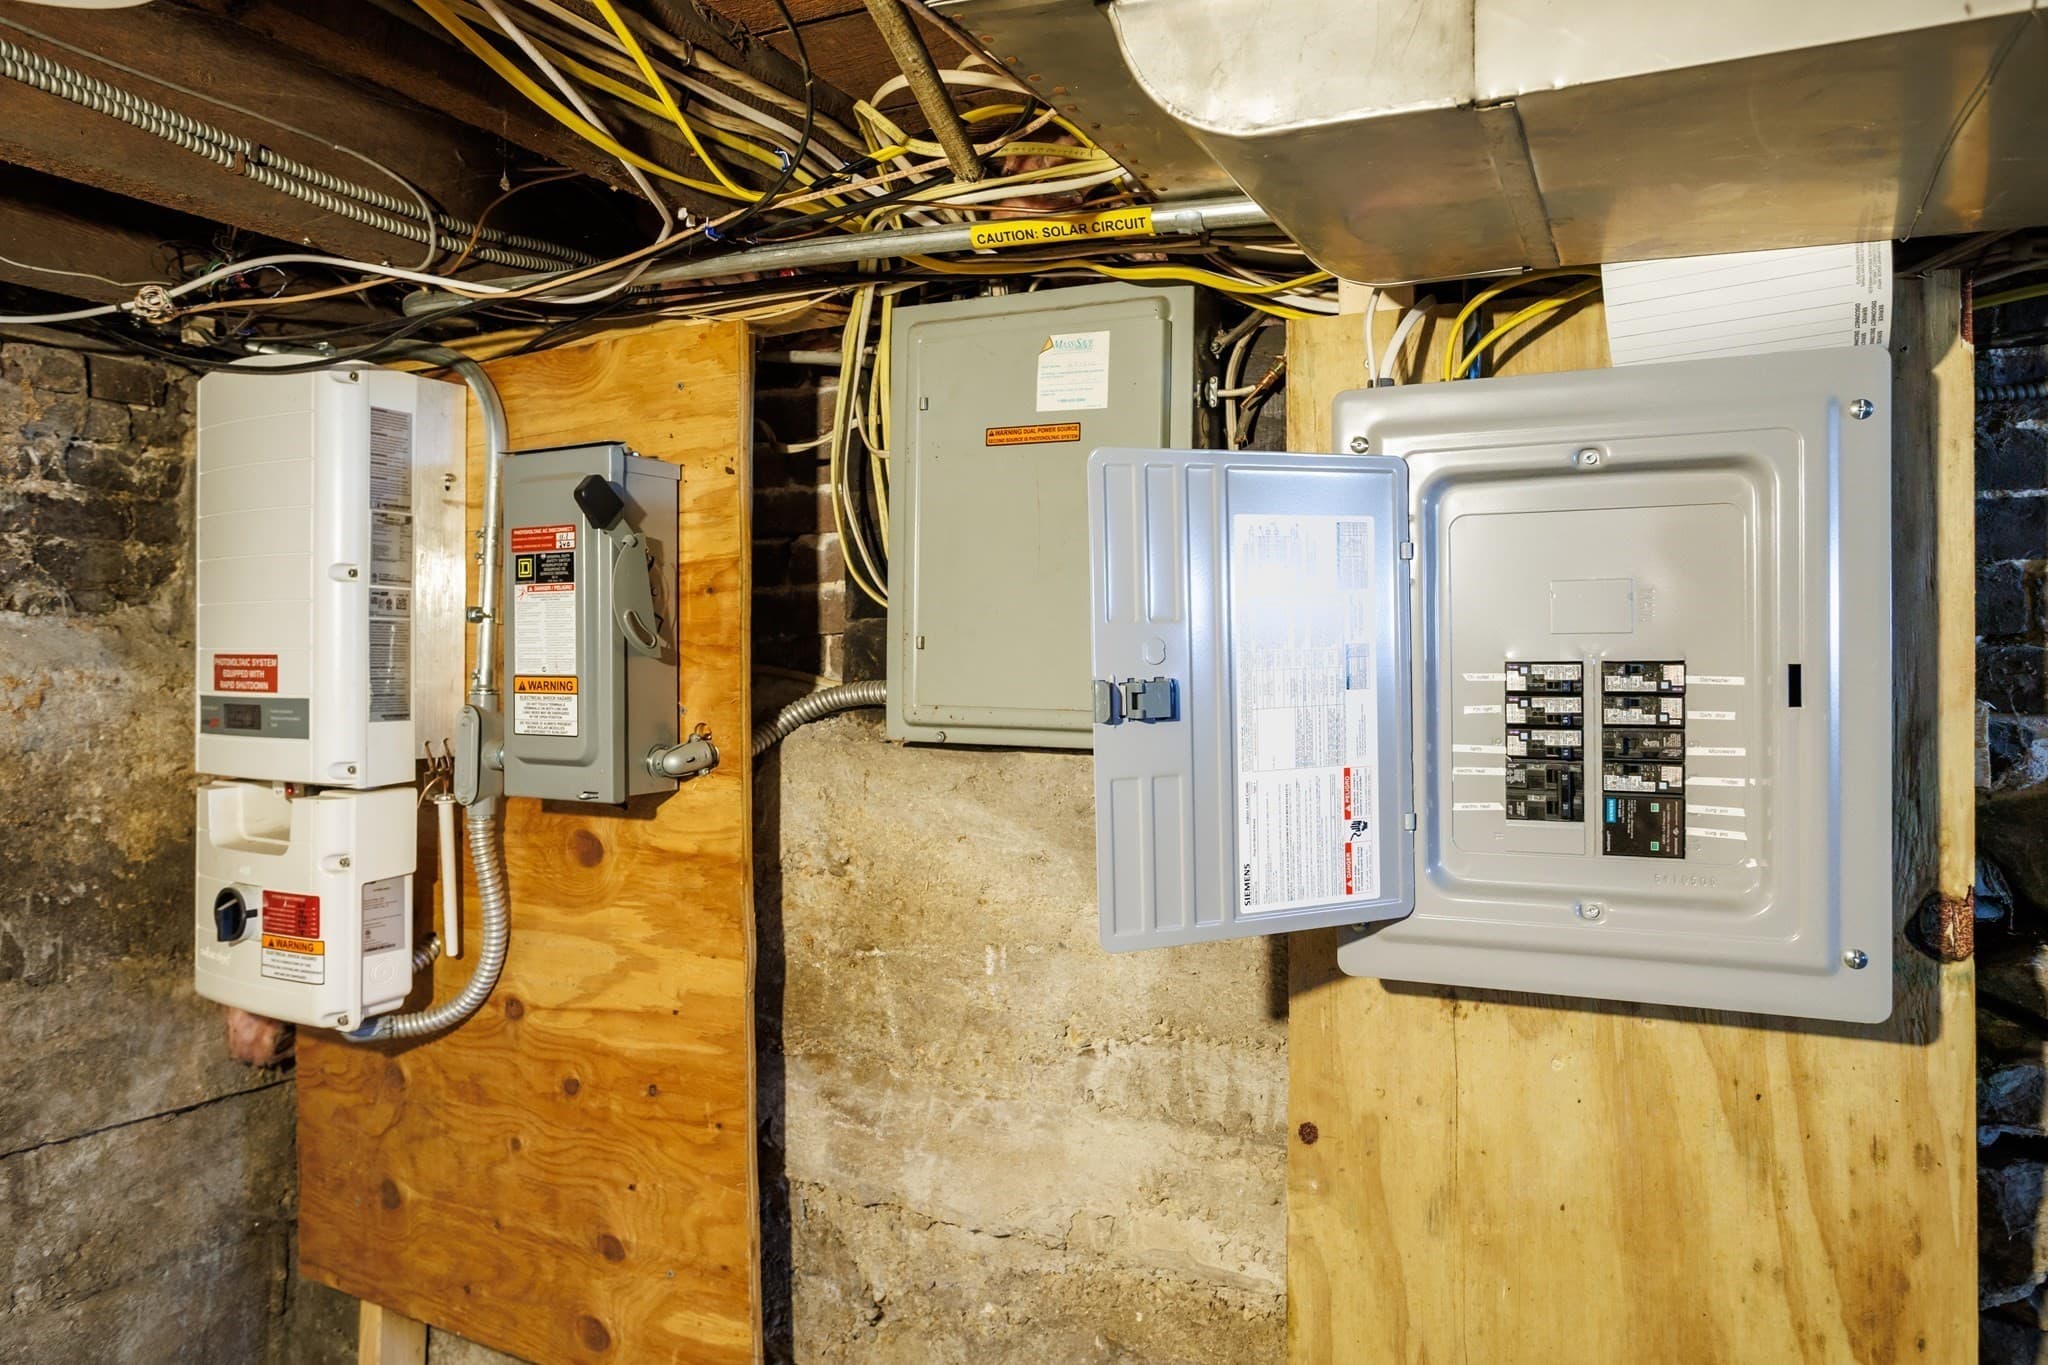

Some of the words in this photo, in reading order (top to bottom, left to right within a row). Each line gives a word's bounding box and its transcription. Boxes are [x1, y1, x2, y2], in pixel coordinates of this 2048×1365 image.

[976, 228, 1039, 245] CAUTION:
[1042, 223, 1088, 238] SOLAR
[1092, 216, 1146, 232] CIRCUIT
[528, 680, 574, 691] WARNING
[276, 939, 314, 952] WARNING
